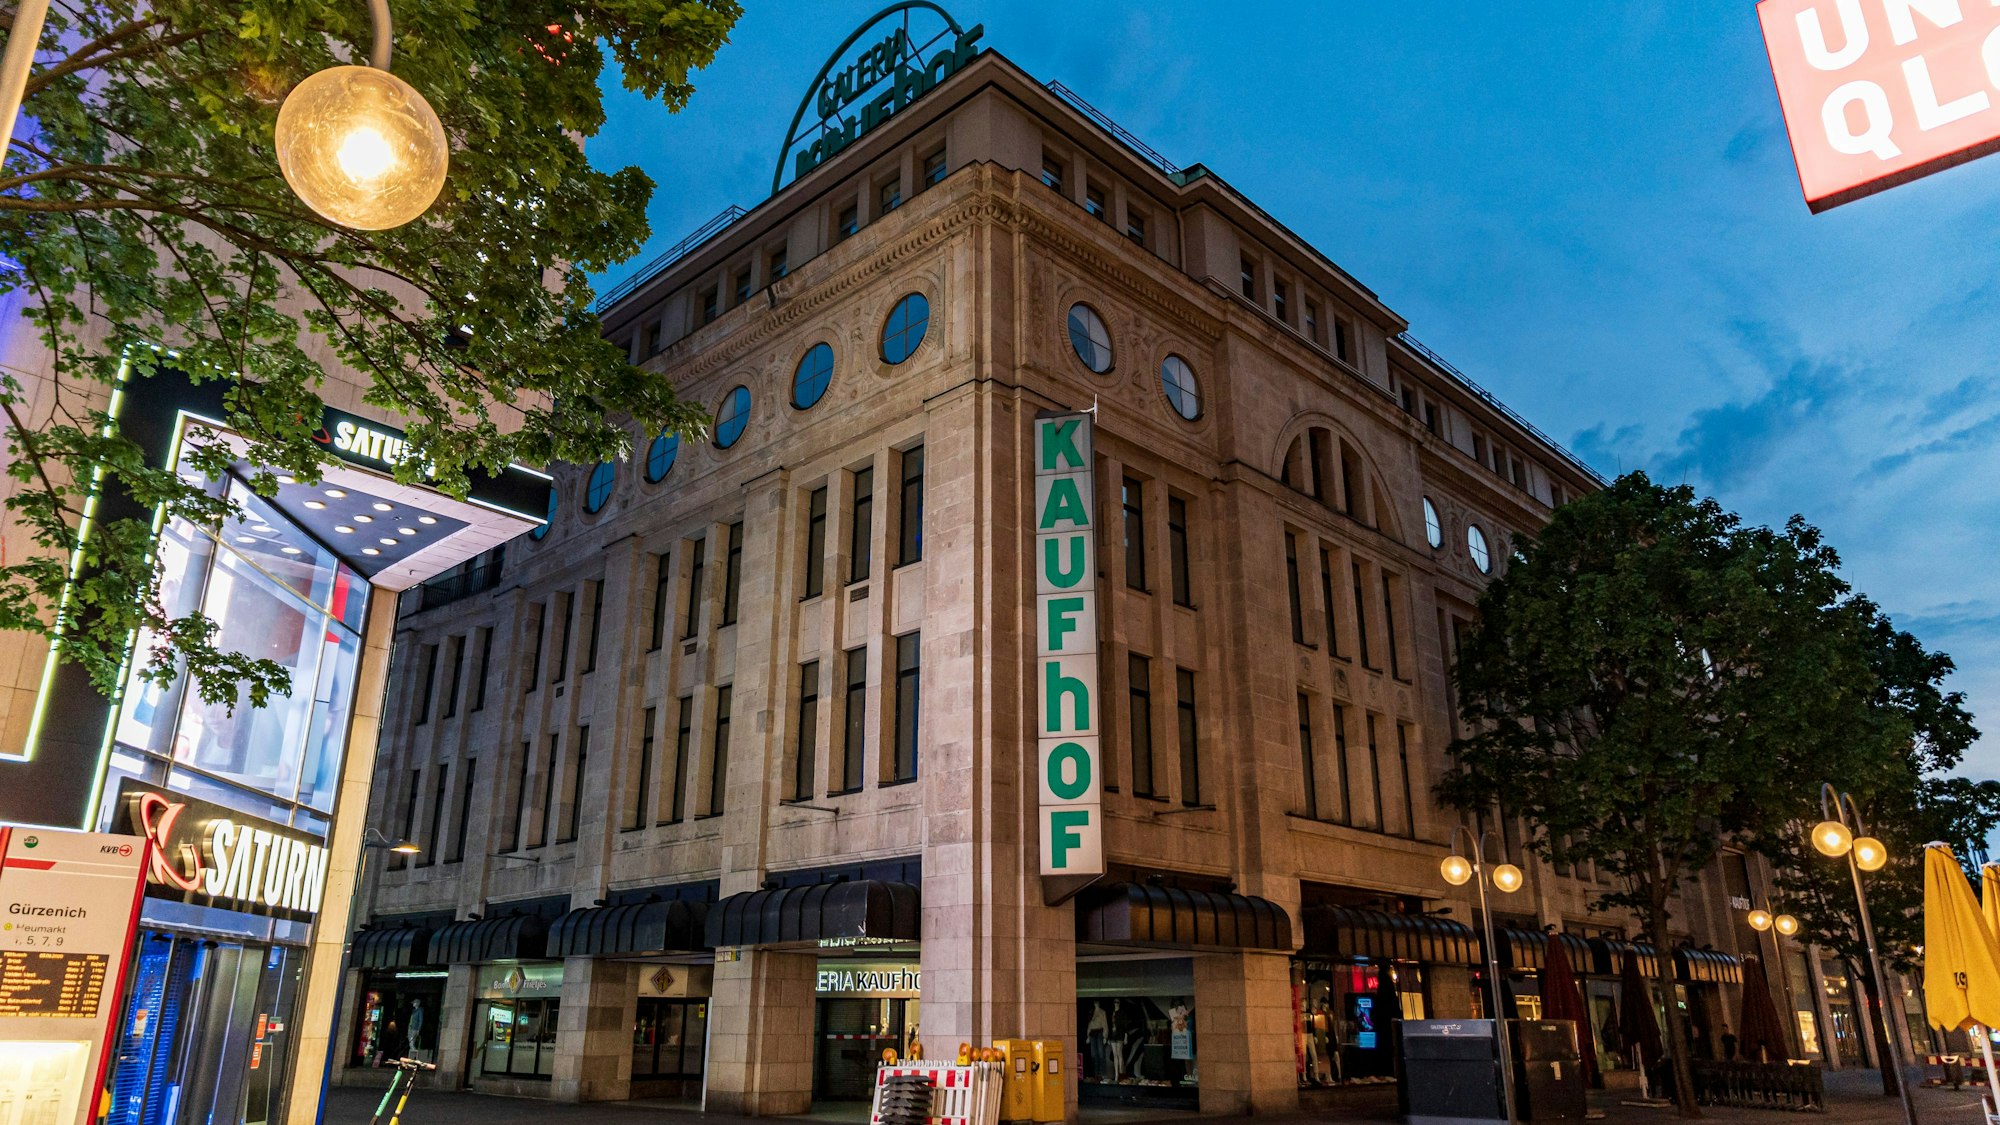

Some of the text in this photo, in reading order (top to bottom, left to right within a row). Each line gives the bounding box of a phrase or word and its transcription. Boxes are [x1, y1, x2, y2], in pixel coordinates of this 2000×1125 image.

[1796, 0, 2000, 71] UN
[817, 27, 908, 119] GALERIA
[1821, 25, 2000, 161] QL
[100, 845, 119, 854] KVB
[205, 819, 329, 913] SATURN
[9, 903, 87, 918] Gürzenich
[56, 937, 64, 946] 9
[816, 971, 855, 991] ERIA
